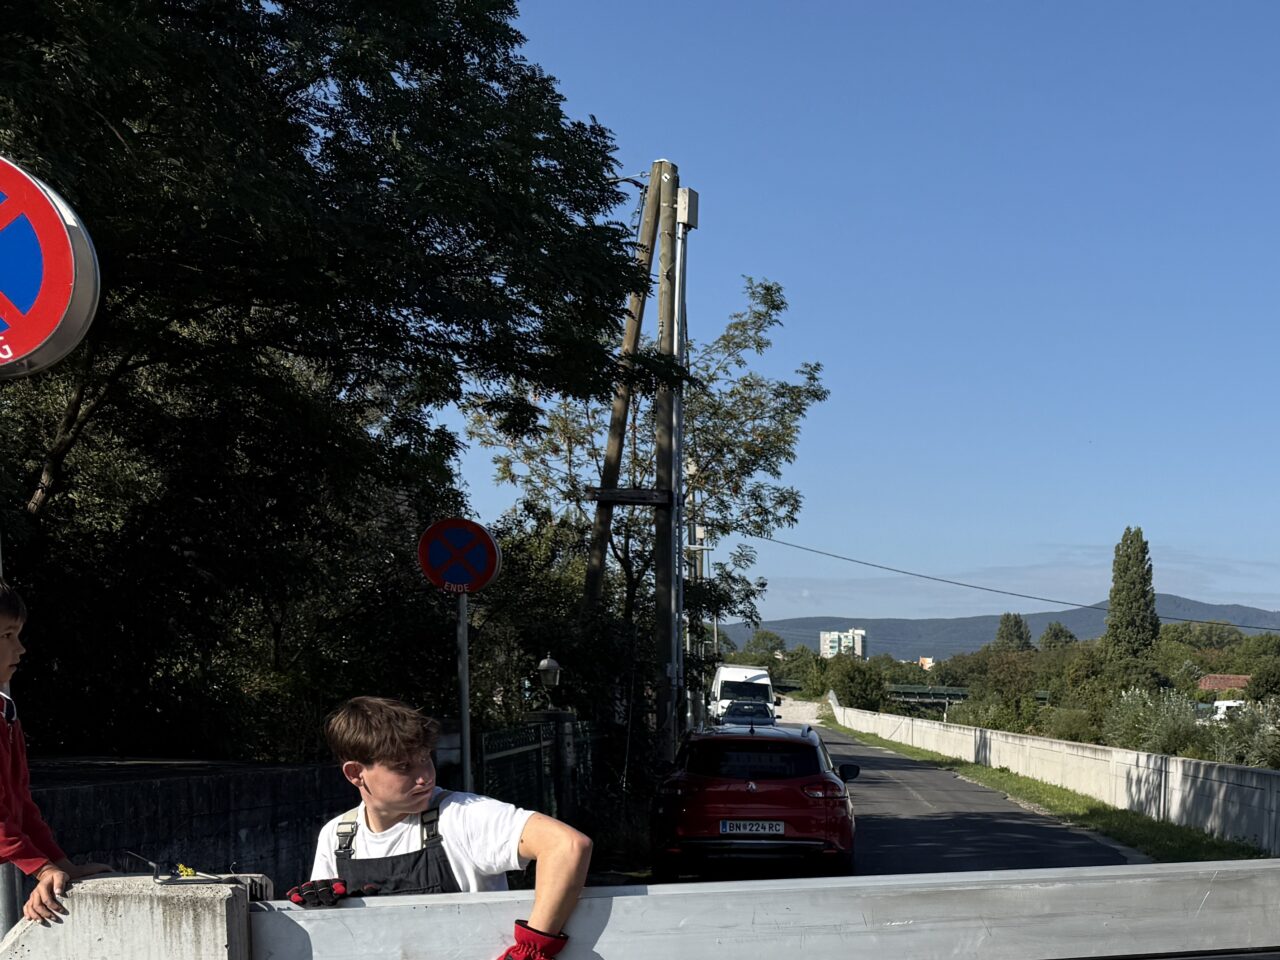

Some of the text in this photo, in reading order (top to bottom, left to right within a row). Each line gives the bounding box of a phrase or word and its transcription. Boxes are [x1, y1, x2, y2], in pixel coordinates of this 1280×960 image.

[443, 581, 470, 593] ENDE
[729, 822, 780, 832] BN 224 RC
